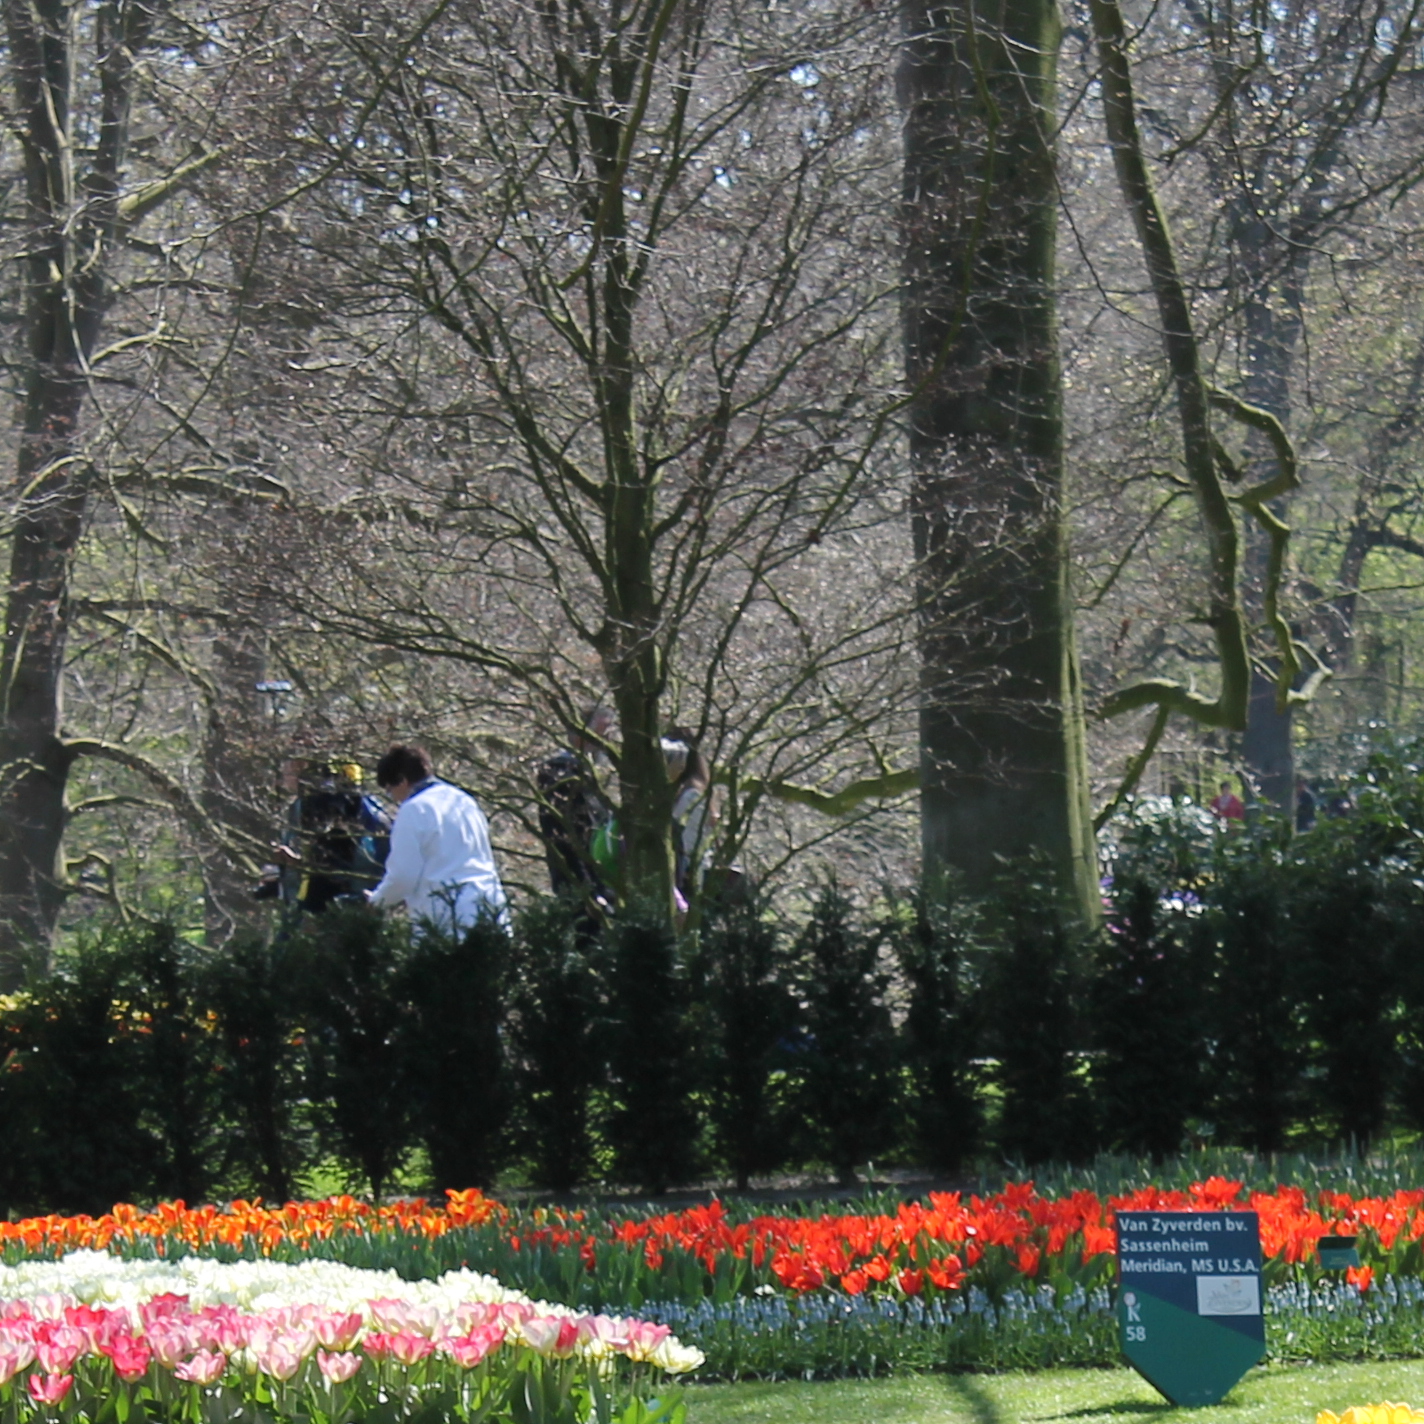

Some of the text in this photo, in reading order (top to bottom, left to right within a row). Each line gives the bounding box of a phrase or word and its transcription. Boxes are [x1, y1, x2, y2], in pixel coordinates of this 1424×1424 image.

[1119, 1217, 1248, 1235] Van Zyverden bv.
[1121, 1238, 1209, 1252] Sassenheim
[1121, 1259, 1259, 1274] Meridian, MS U.S.A.
[1126, 1327, 1146, 1341] 58
